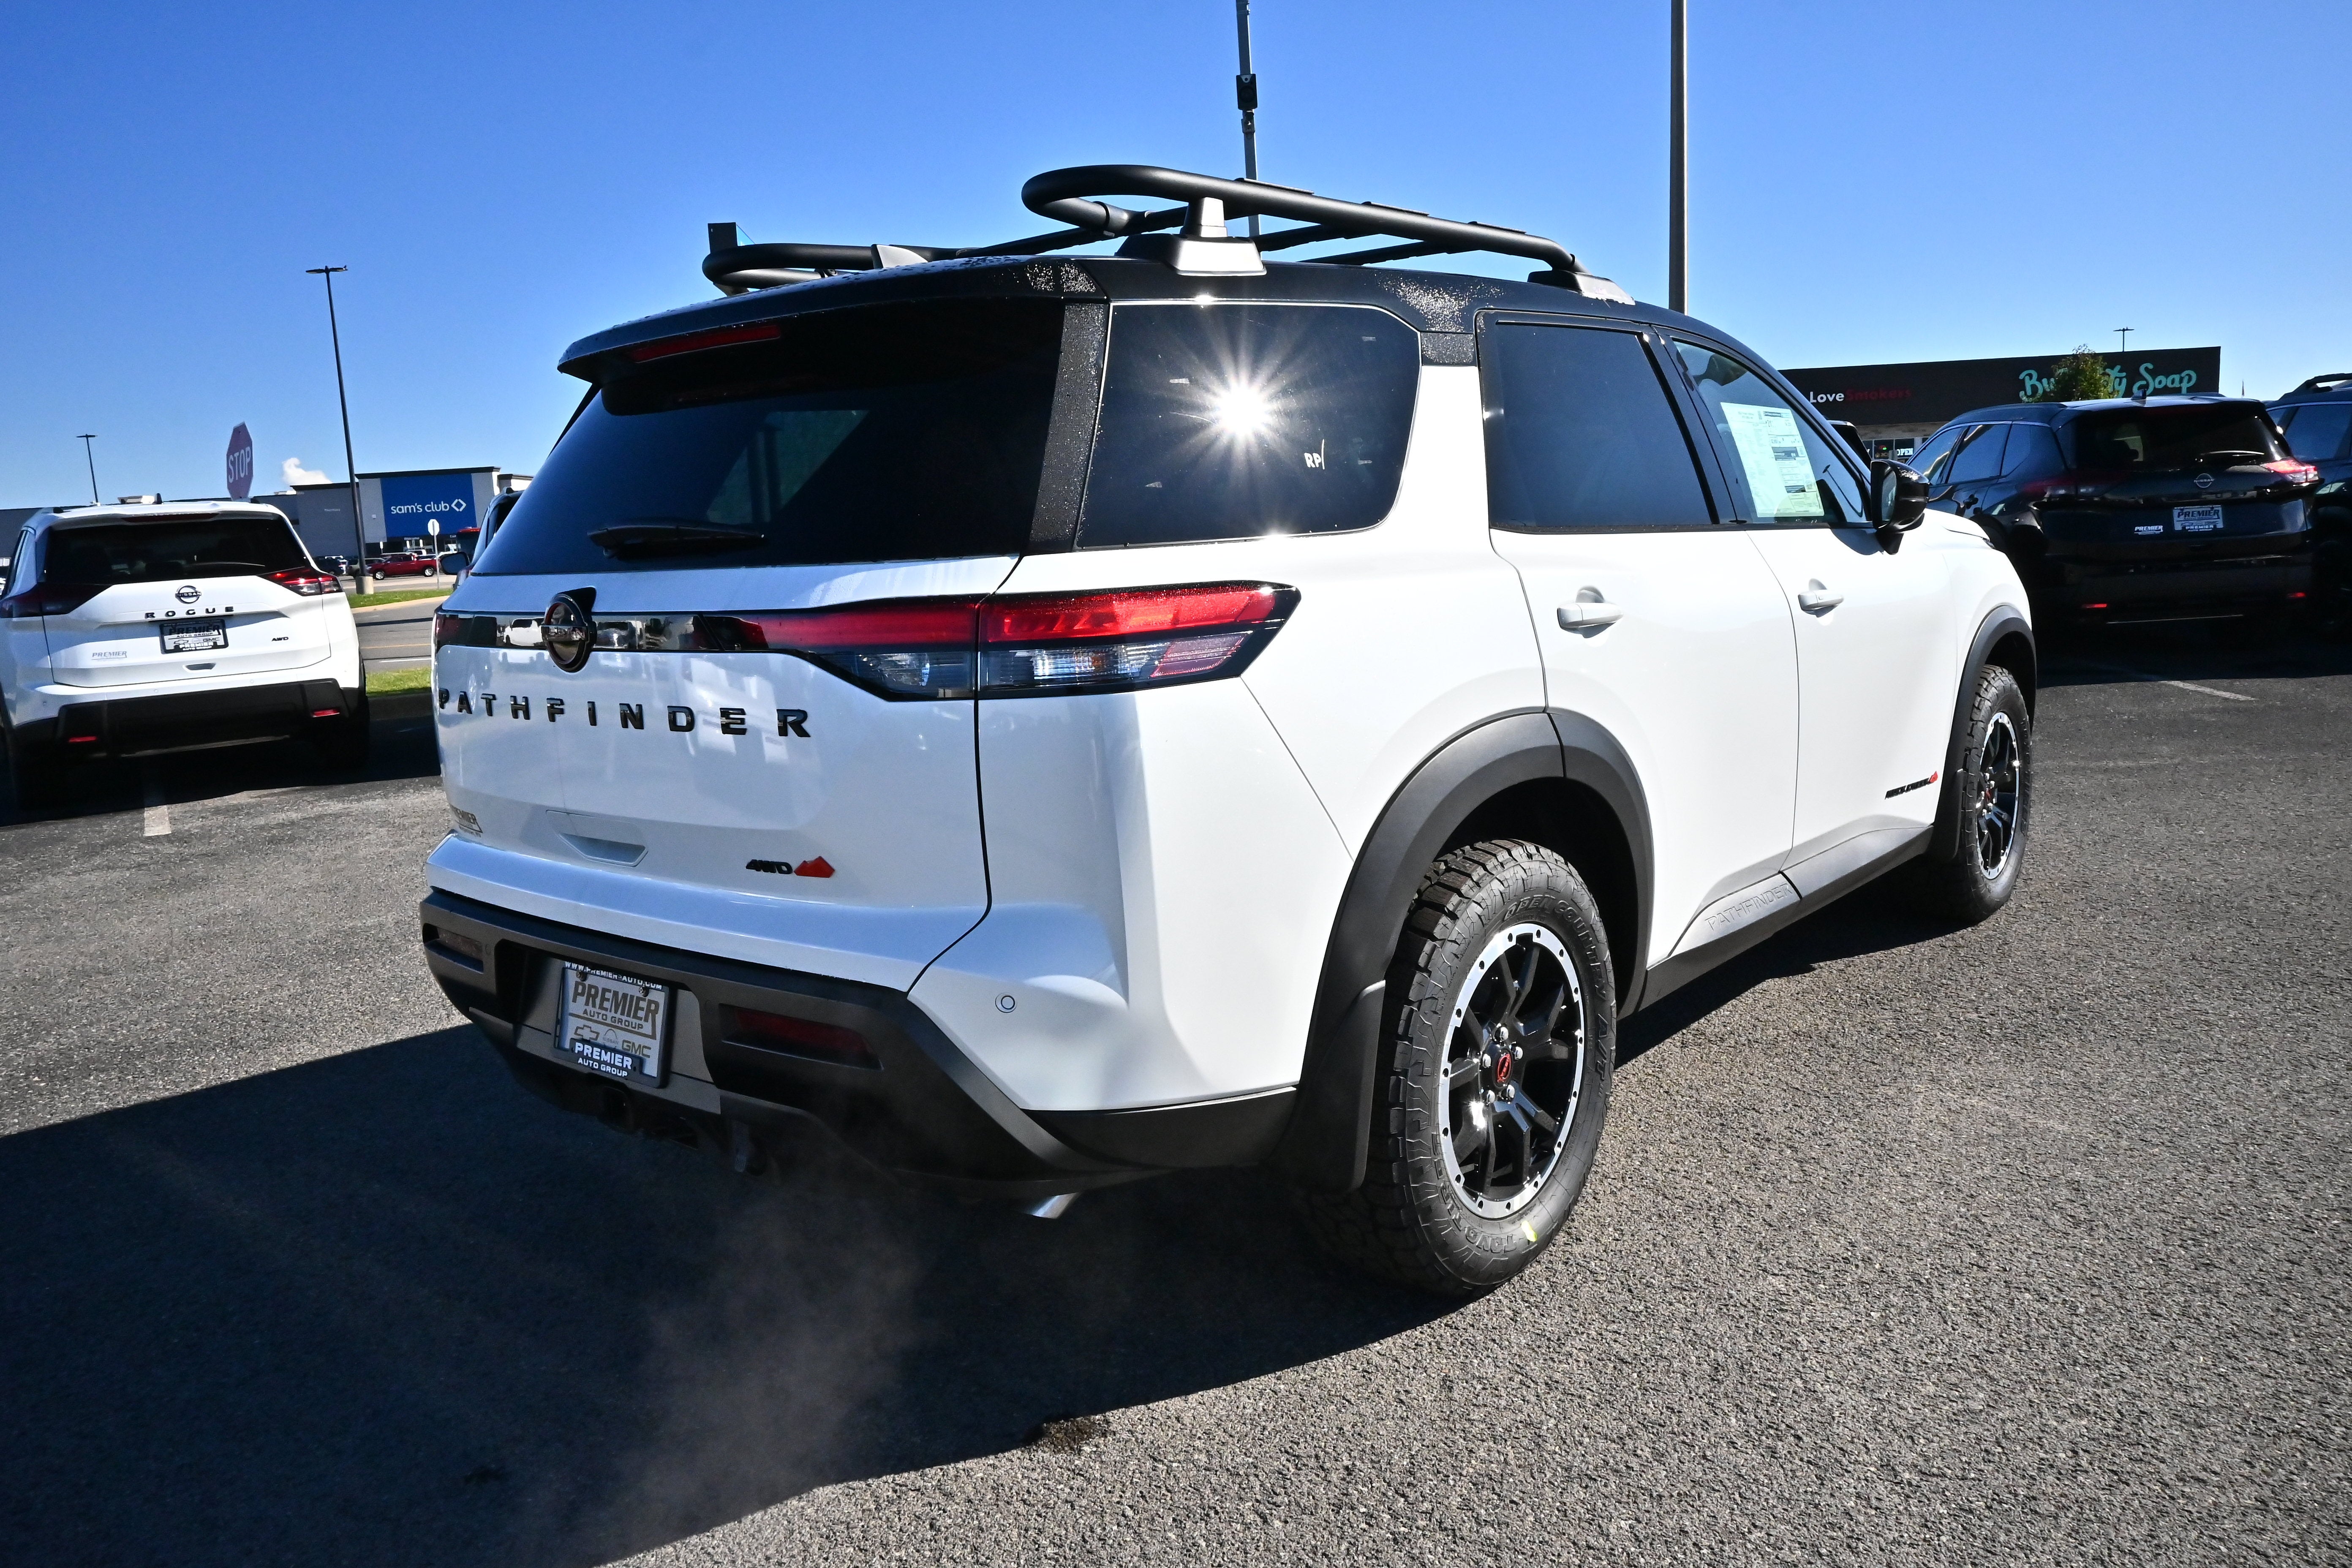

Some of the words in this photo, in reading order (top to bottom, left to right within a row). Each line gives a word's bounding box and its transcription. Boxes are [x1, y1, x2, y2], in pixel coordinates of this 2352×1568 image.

[2132, 363, 2196, 395] Soap
[1810, 391, 1844, 403] Love
[229, 446, 251, 483] STOP
[391, 503, 422, 514] sam's
[425, 501, 450, 512] club
[2178, 509, 2220, 518] PREMIER
[144, 606, 234, 619] ROGUE
[169, 625, 220, 635] PREMIER
[438, 687, 811, 738] PATHFINDER
[1704, 882, 1794, 931] PATHFINDER
[572, 980, 660, 1023] PREMIER
[582, 1008, 607, 1021] AUTO
[610, 1017, 643, 1031] GROUP
[575, 1042, 633, 1070] PREMIER
[621, 1039, 652, 1058] GMC
[578, 1058, 599, 1069] AUTO
[601, 1065, 628, 1077] GROUP
